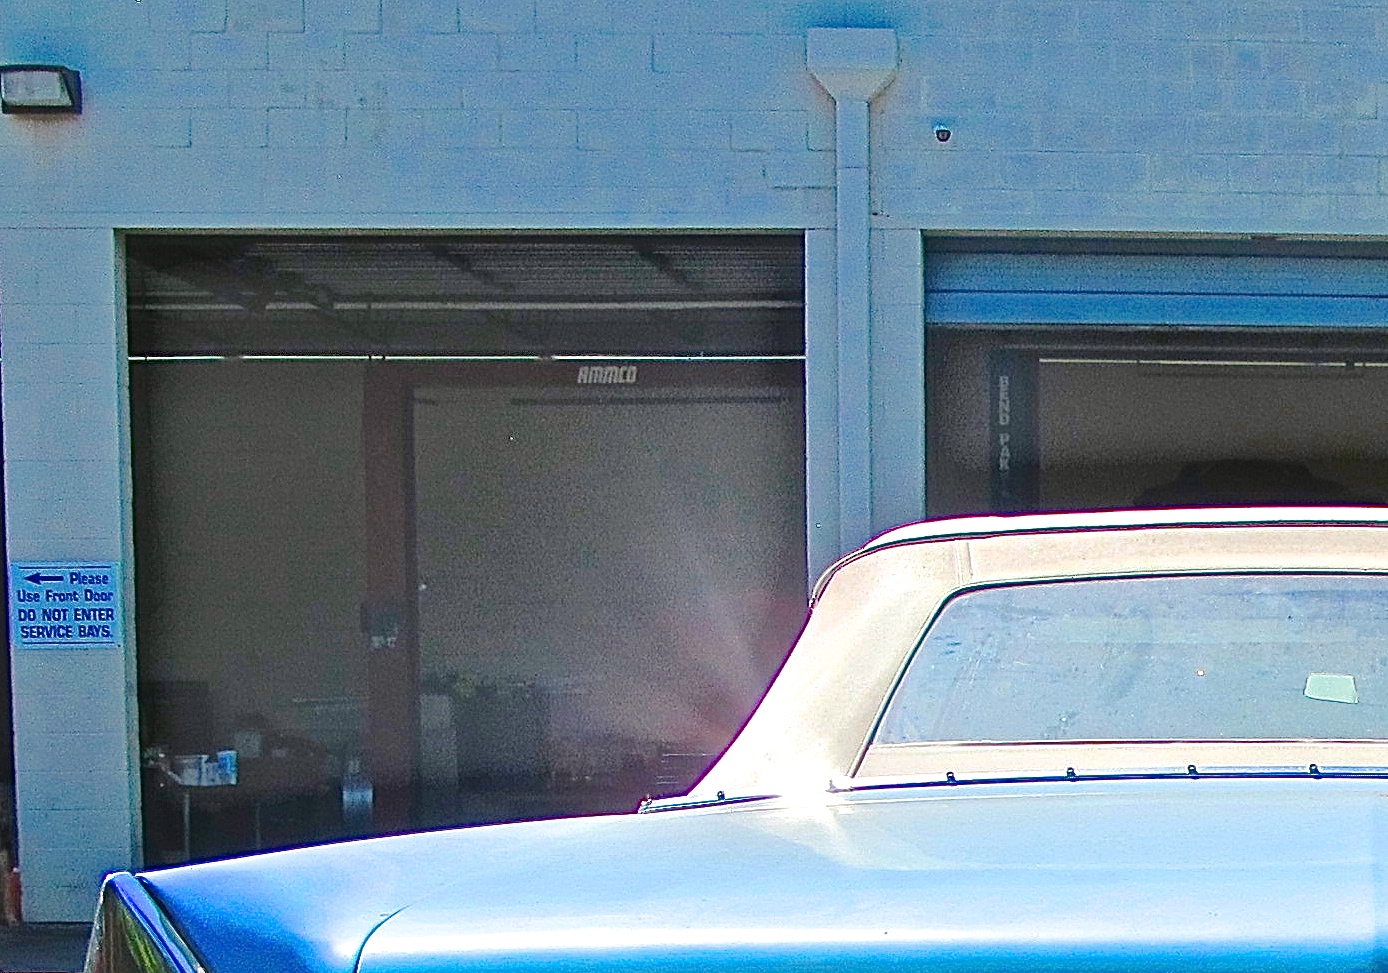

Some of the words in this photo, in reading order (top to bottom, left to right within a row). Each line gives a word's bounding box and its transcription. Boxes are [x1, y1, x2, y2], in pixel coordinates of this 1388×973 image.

[577, 365, 638, 384] AMMCO
[69, 571, 109, 585] Please
[17, 589, 40, 602] Use
[45, 589, 79, 602] Front
[84, 588, 114, 602] Door
[18, 608, 36, 622] DO
[42, 608, 69, 622] NOT
[74, 608, 115, 621] ENTER
[21, 625, 73, 639] SERVICE
[78, 625, 114, 638] BAYS.
